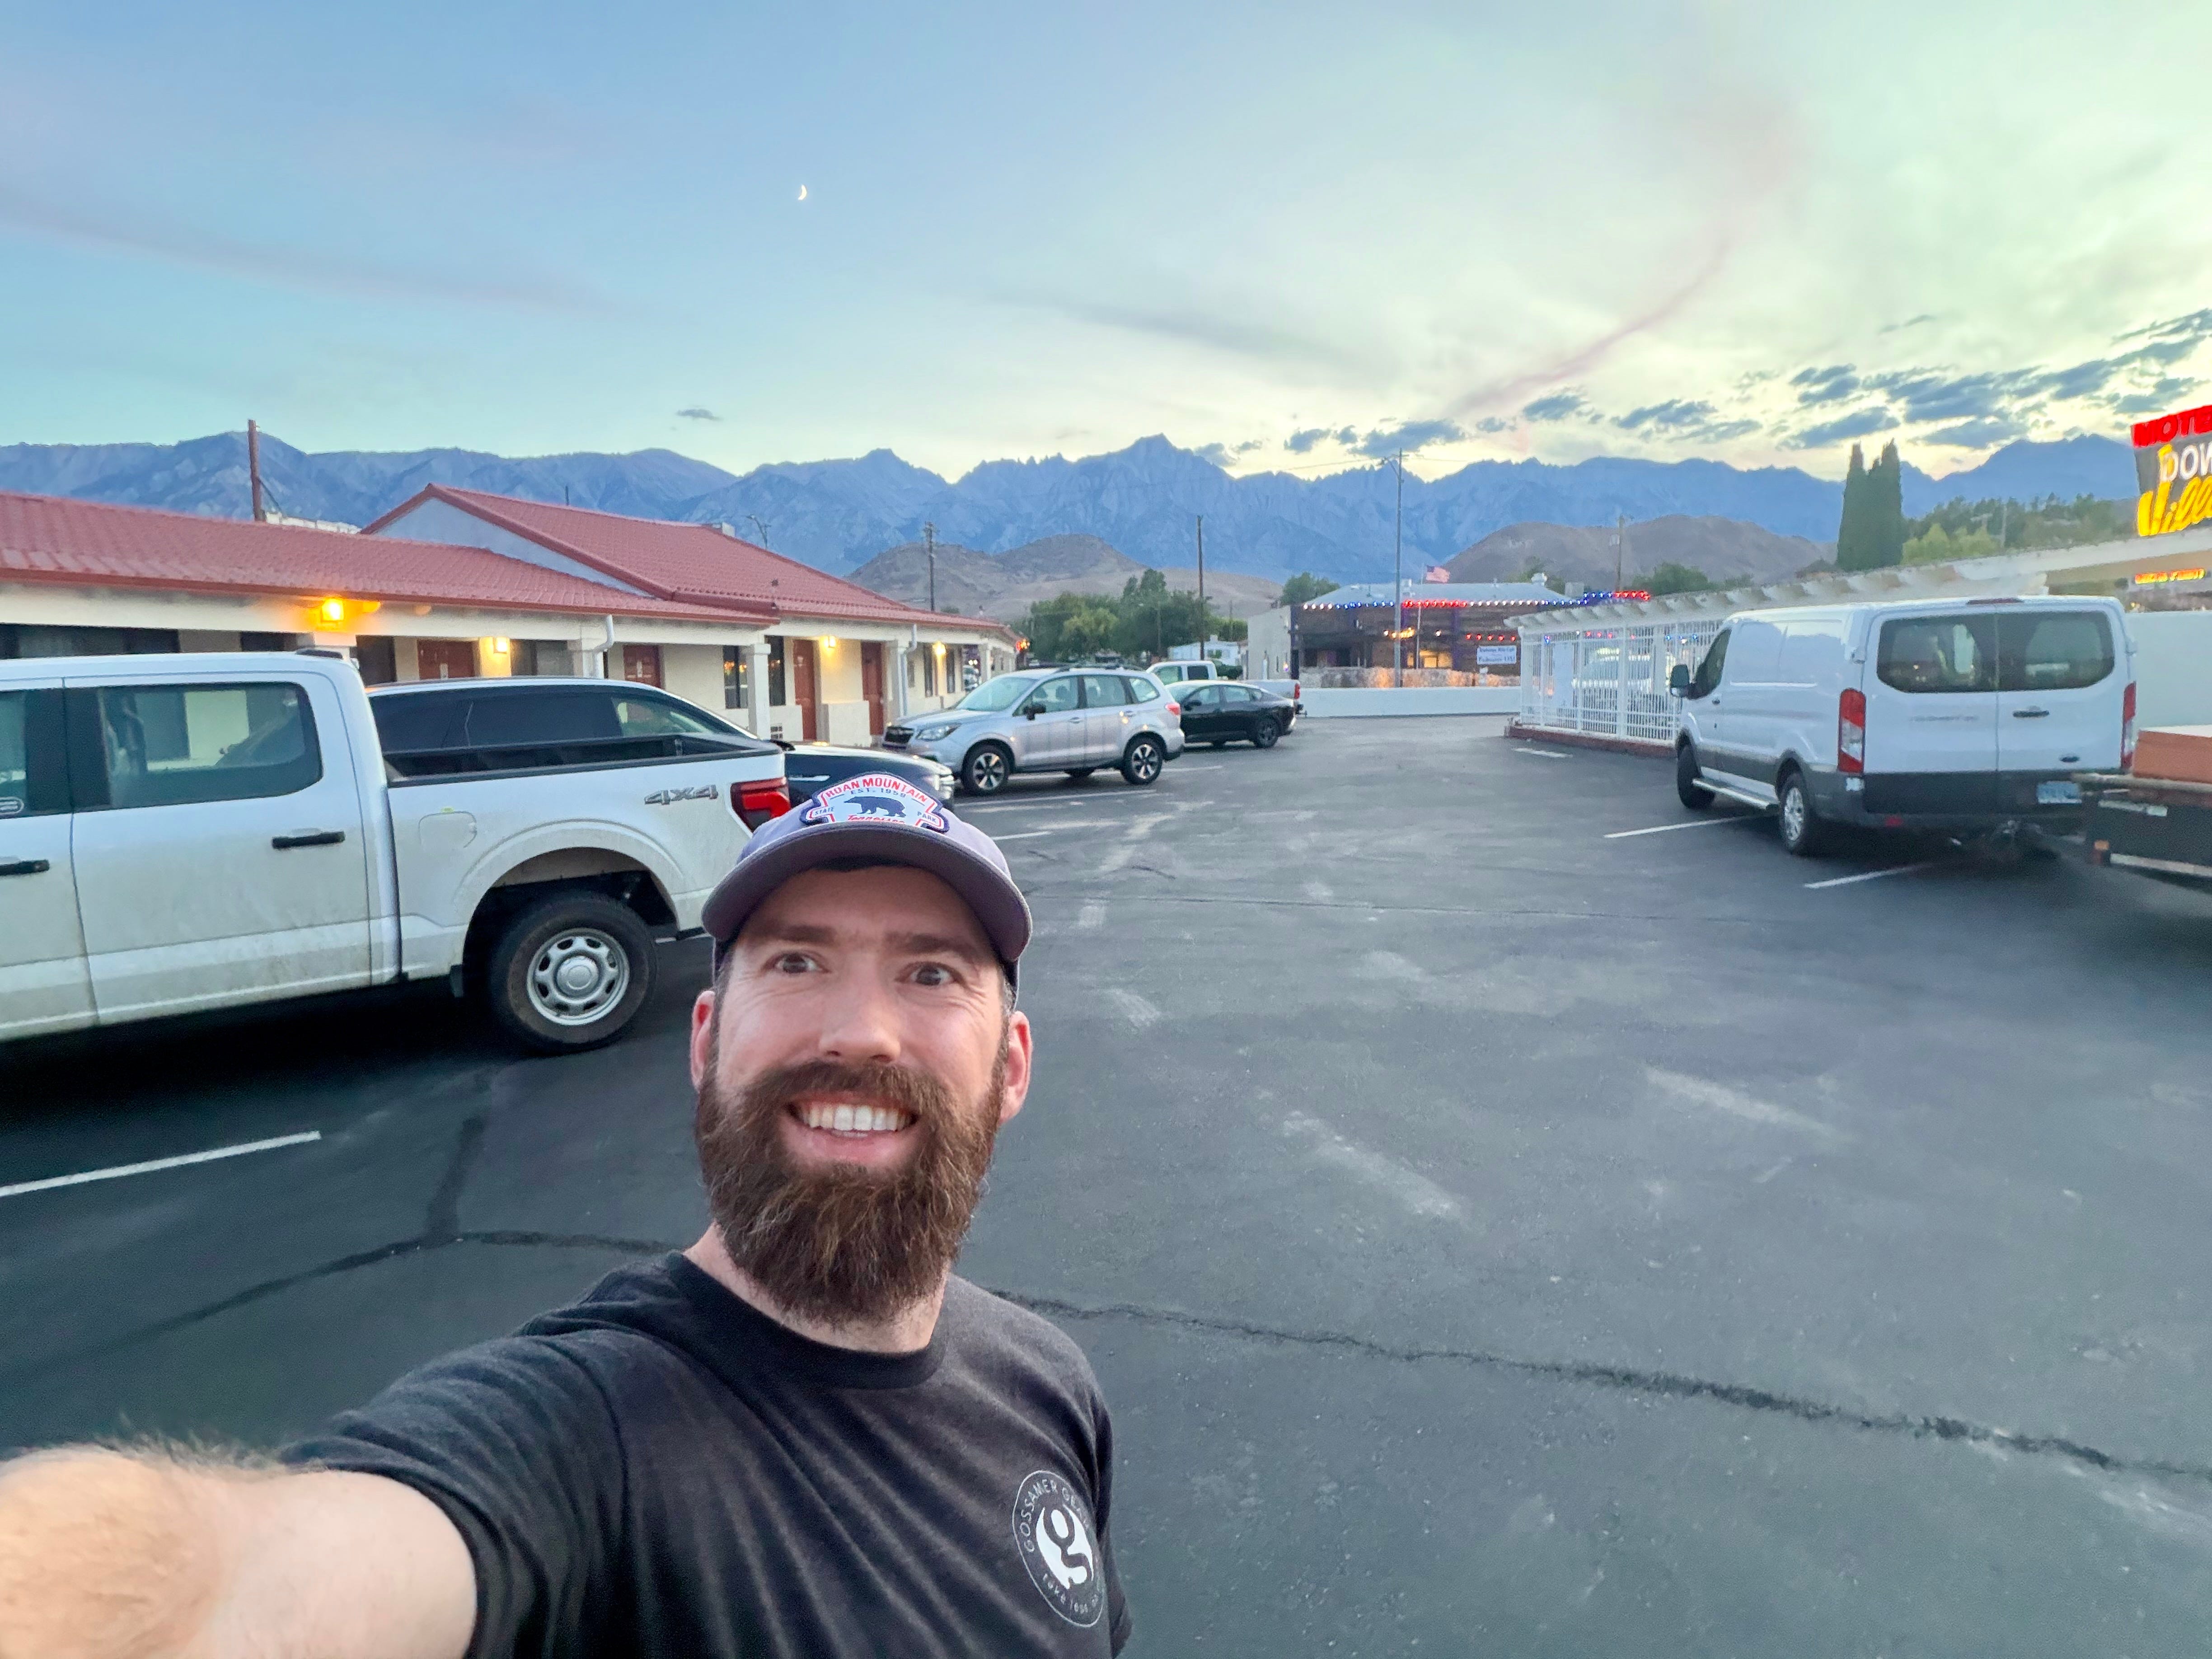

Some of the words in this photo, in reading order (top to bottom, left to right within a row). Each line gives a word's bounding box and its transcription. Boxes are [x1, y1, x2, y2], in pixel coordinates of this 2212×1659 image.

[826, 780, 860, 798] ROAN
[862, 778, 928, 802] MOUNTAIN
[815, 806, 835, 816] STATE
[917, 811, 937, 823] PARK
[1019, 1479, 1058, 1553] GOSSAMER
